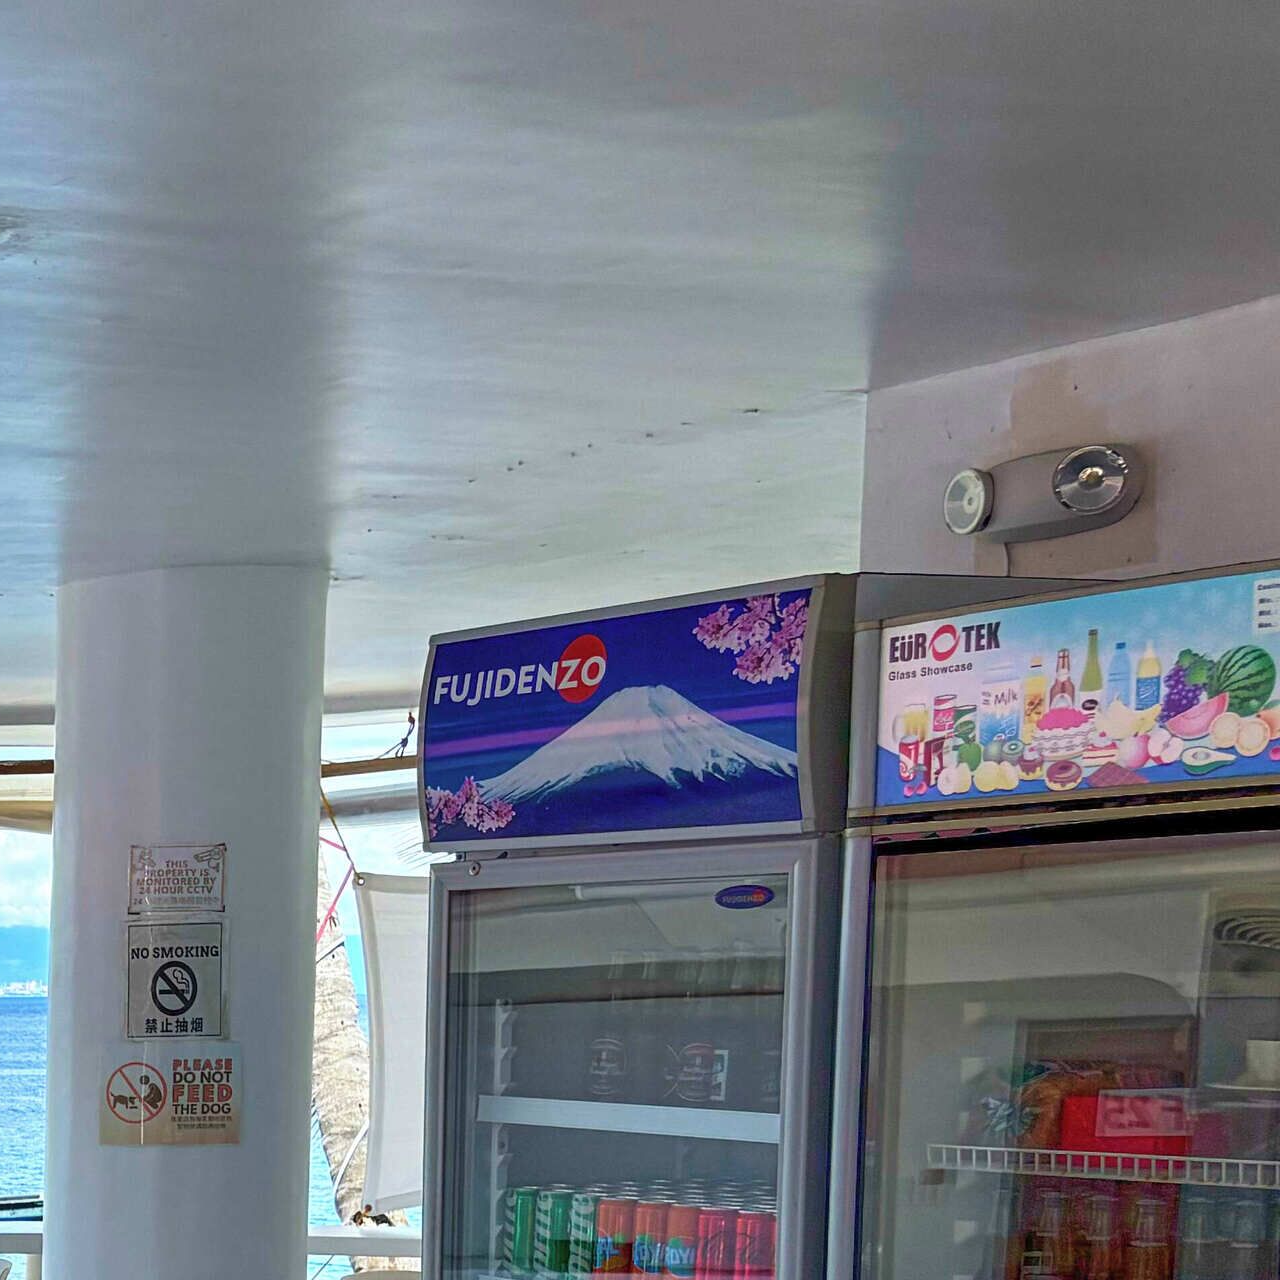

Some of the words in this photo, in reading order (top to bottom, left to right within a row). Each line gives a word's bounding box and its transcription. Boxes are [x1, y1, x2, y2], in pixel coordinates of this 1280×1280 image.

[888, 670, 917, 682] Glass
[920, 662, 973, 677] Showcase
[433, 655, 606, 706] FUJIDENZO
[994, 688, 1018, 705] Milk
[165, 860, 188, 868] THIS
[200, 869, 209, 877] IS
[137, 877, 200, 886] MONITORED
[203, 876, 216, 885] BY
[154, 886, 184, 895] HOUR
[187, 885, 214, 894] CCTV
[131, 947, 149, 960] NO
[152, 945, 219, 959] SMOKING
[145, 1017, 203, 1034] 禁止抽烟
[172, 1058, 233, 1071] PLEASE
[173, 1072, 196, 1084] DO
[200, 1071, 233, 1083] NOT
[172, 1084, 233, 1103] FEED
[172, 1103, 198, 1115] THE
[201, 1103, 231, 1115] DOG
